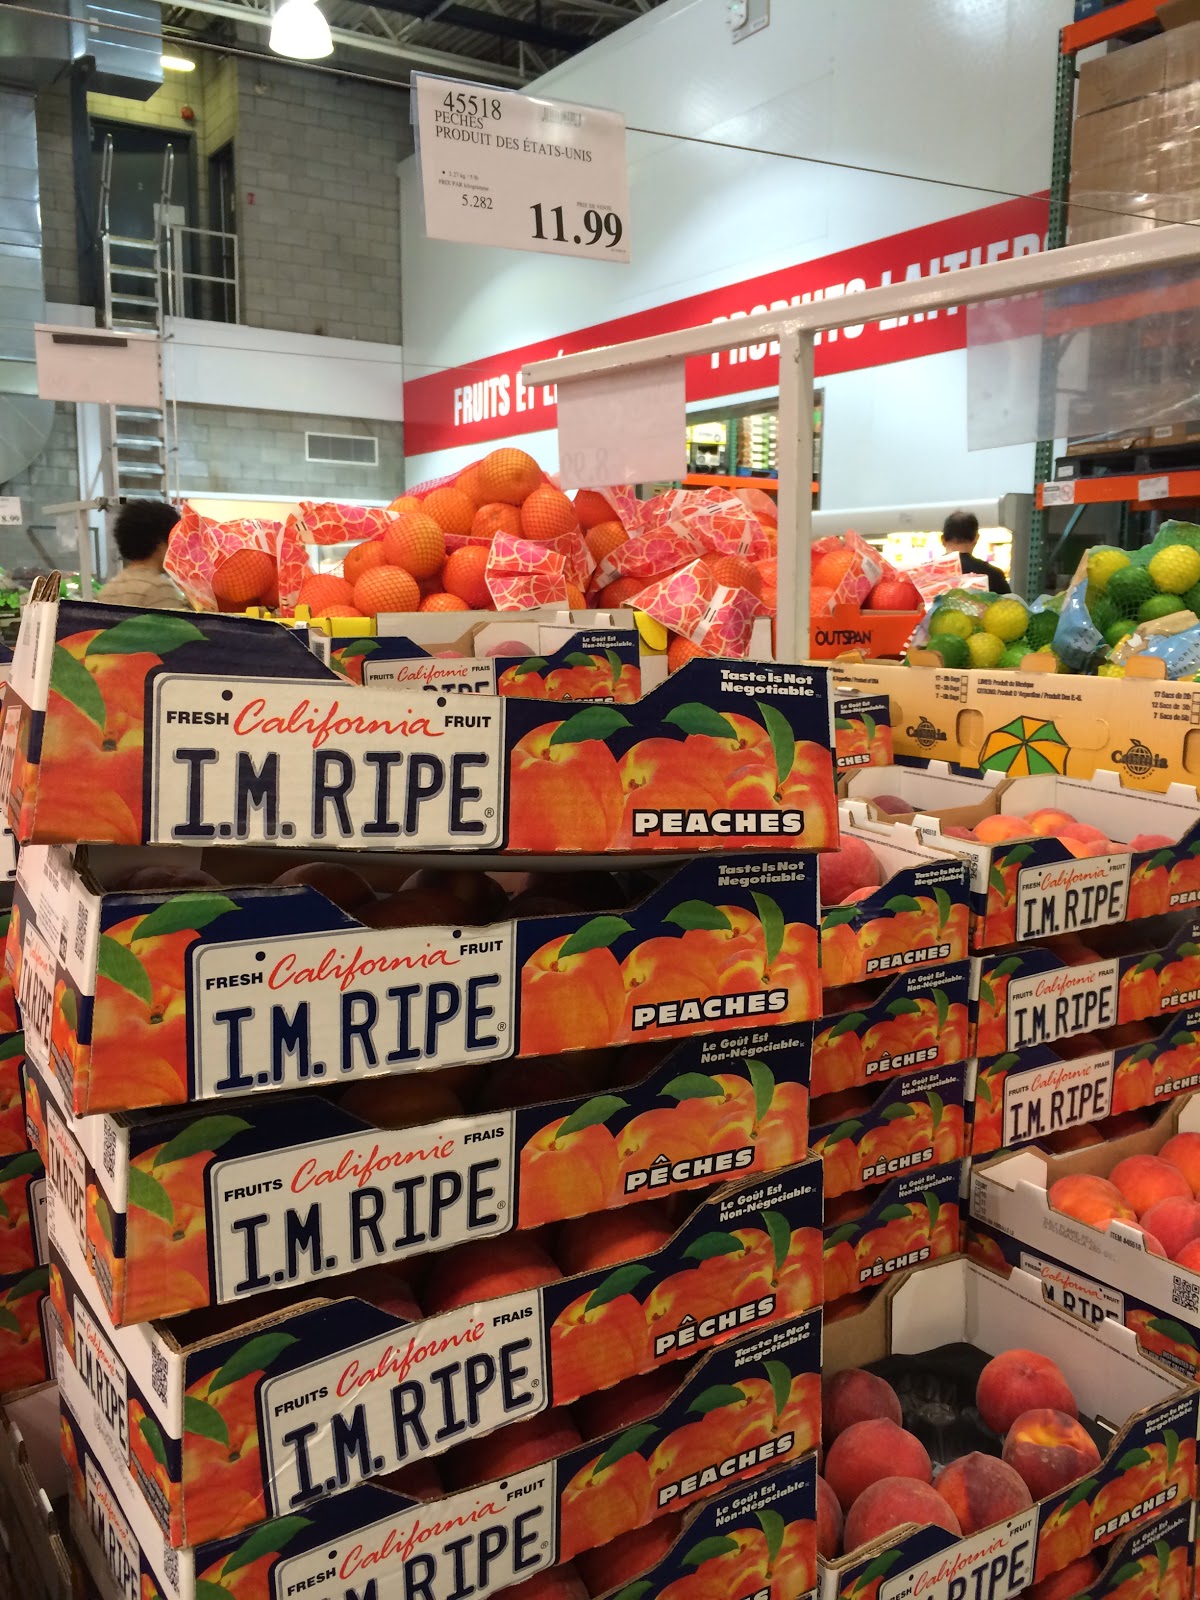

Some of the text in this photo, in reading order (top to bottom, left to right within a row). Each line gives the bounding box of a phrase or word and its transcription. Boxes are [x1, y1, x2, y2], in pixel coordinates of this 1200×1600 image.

[434, 109, 484, 130] PECHES
[443, 91, 502, 121] 45518
[435, 125, 592, 163] PRODUIT DES ÉTATS-UNIS
[462, 194, 494, 210] 5.282
[529, 202, 623, 248] 11.99
[454, 374, 511, 427] FRUITS
[369, 664, 491, 684] FRUITS Californie FRAIS
[720, 669, 814, 686] Taste Is Not
[720, 682, 815, 699] Negotiable
[166, 697, 492, 749] FRESH California FRUIT
[837, 754, 870, 767] CHES
[312, 747, 489, 840] RIPE
[633, 809, 804, 836] PEACHES
[718, 861, 805, 876] Taste Is Not
[718, 871, 806, 888] Negotiable
[1022, 863, 1126, 892] FRESH California FRUIT
[1064, 880, 1124, 931] RIPE
[206, 940, 503, 992] FRESH California FRUIT
[866, 944, 951, 973] PEACHES
[1012, 967, 1115, 1001] FRUITS Californie FRAIS
[339, 973, 502, 1073] RIPE
[633, 990, 789, 1029] PEACHES
[1055, 985, 1113, 1042] RIPE
[701, 1039, 800, 1064] Non-Négociable
[702, 1032, 769, 1052] Le Goût Est
[865, 1046, 939, 1076] PÊCHES
[1008, 1060, 1110, 1097] FRUITS Californie FRAIS
[1050, 1076, 1108, 1133] RIPE
[224, 1127, 505, 1202] FRUITS Californie FRAIS
[625, 1147, 754, 1192] PÊCHES
[862, 1147, 934, 1181] PÊCHES
[349, 1157, 502, 1265] RIPE
[719, 1184, 812, 1222] Non-Négociable
[720, 1183, 783, 1211] Le Goût Est
[859, 1246, 931, 1282] PÊCHES
[1040, 1266, 1103, 1300] California
[1063, 1289, 1119, 1324] RIP
[654, 1296, 777, 1358] PÊCHES
[734, 1339, 773, 1358] Taste
[785, 1321, 810, 1339] Not
[274, 1306, 533, 1418] FRUITS Californie FRAIS
[734, 1332, 811, 1367] Negotiable
[390, 1336, 535, 1461] RIPE
[657, 1434, 795, 1506] PEACHES
[716, 1481, 776, 1517] Le Goût Est
[1092, 1484, 1179, 1542] PEACHES
[287, 1567, 337, 1597] FRESH
[338, 1500, 507, 1580] California
[506, 1478, 546, 1502] FRUIT
[402, 1504, 545, 1600] RIPE
[913, 1519, 1033, 1597] California FRUIT
